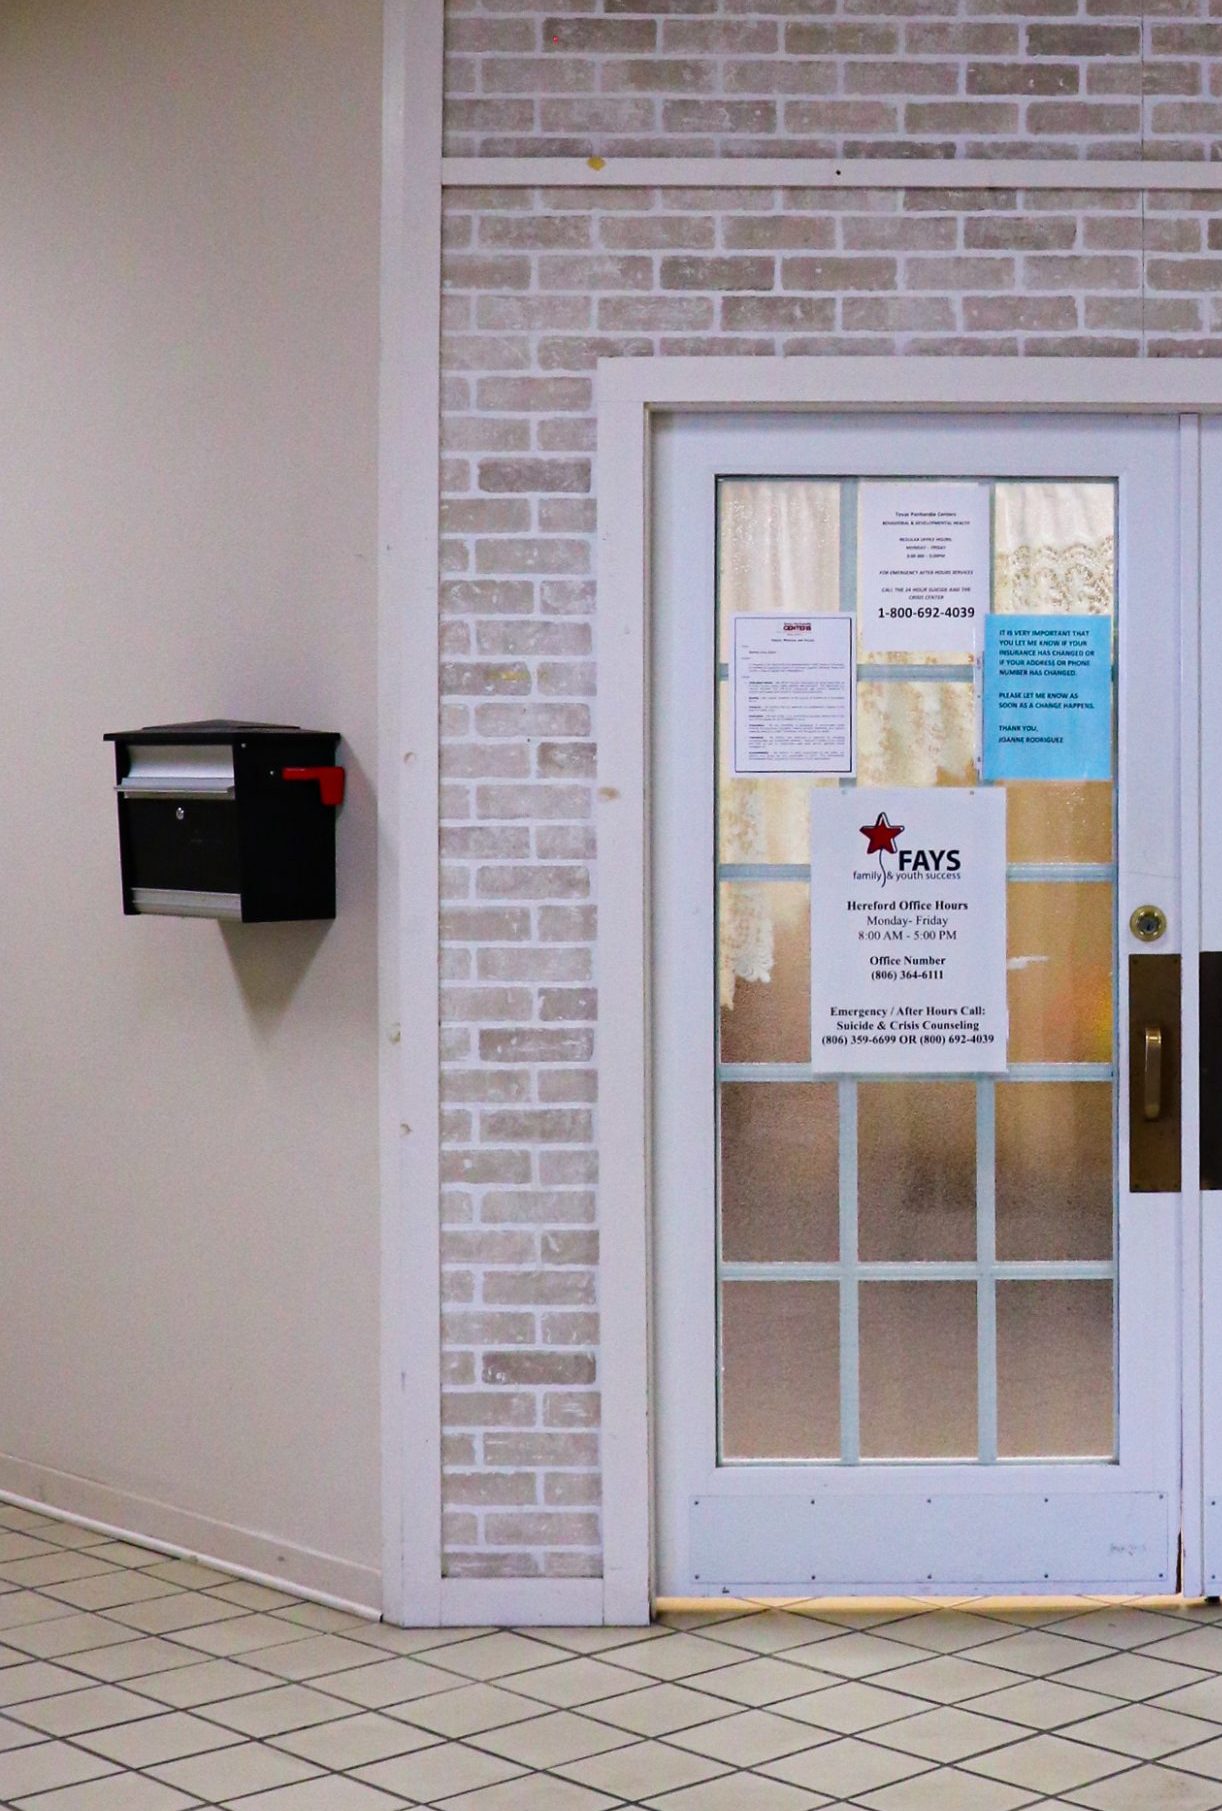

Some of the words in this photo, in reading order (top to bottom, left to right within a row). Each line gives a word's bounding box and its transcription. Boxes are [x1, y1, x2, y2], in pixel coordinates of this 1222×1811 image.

[878, 607, 975, 618] 1-800-692-4039
[898, 850, 961, 871] FAYS
[853, 870, 882, 882] family
[887, 871, 894, 880] &
[896, 871, 923, 882] youth
[925, 872, 961, 880] success
[847, 900, 896, 911] Hereford
[899, 900, 932, 911] Office
[935, 900, 968, 911] Hours
[916, 916, 948, 928] Friday
[858, 931, 881, 941] 8:00
[883, 931, 903, 941] AM
[913, 931, 936, 941] 5:00
[939, 931, 957, 941] PM
[869, 956, 901, 966] Office
[903, 956, 946, 966] Number
[871, 970, 897, 981] (806)
[900, 970, 944, 981] 364-6111
[830, 1006, 888, 1018] Emergency
[896, 1006, 925, 1016] After
[927, 1006, 958, 1016] Hours
[960, 1006, 986, 1016] Call:
[836, 1021, 874, 1031] Suicide
[876, 1021, 886, 1031] &
[889, 1021, 919, 1031] Crisis
[922, 1021, 979, 1032] Counseling
[821, 1034, 848, 1046] (806)
[850, 1034, 896, 1046] 359-6699
[899, 1034, 917, 1046] OR
[919, 1034, 946, 1046] (800)
[948, 1034, 994, 1046] 692-4039
